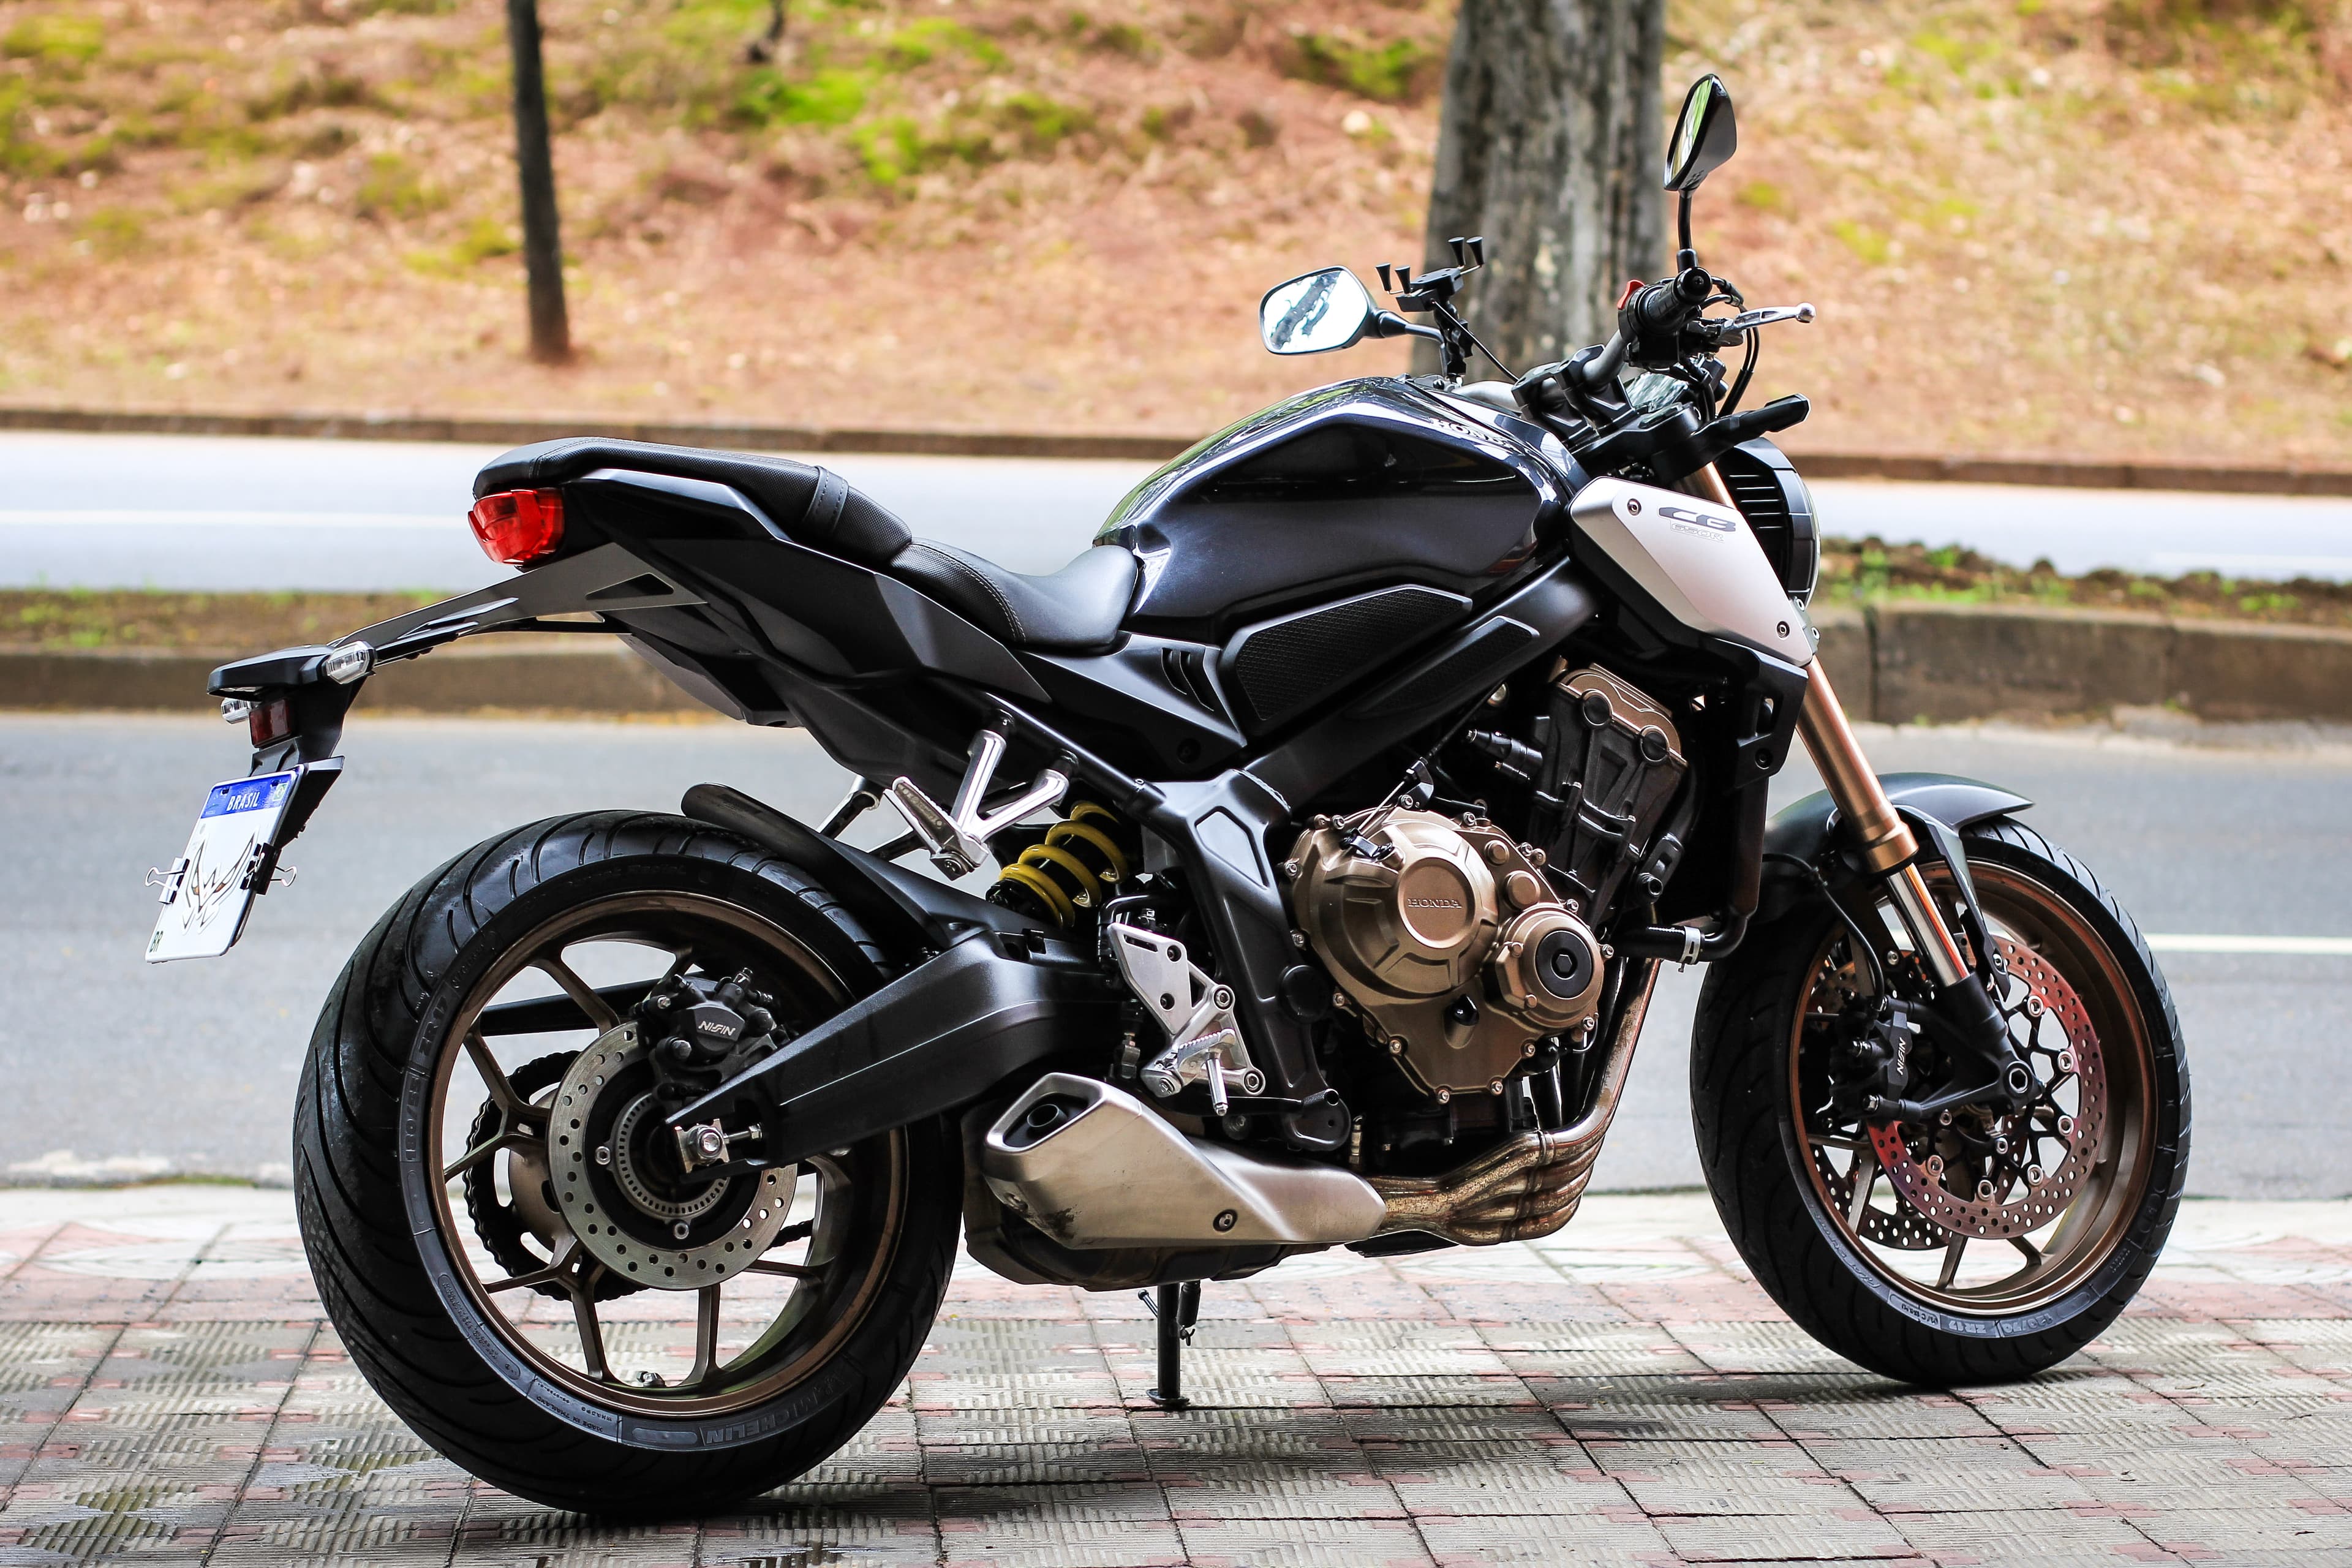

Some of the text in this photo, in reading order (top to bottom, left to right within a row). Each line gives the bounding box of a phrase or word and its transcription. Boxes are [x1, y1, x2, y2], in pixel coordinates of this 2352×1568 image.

[1659, 507, 1736, 532] CB
[1672, 523, 1724, 541] 650R
[226, 791, 260, 812] BRASIL
[1407, 898, 1462, 908] HONDA
[149, 931, 164, 952] BR
[706, 1391, 818, 1444] MICHELIN
